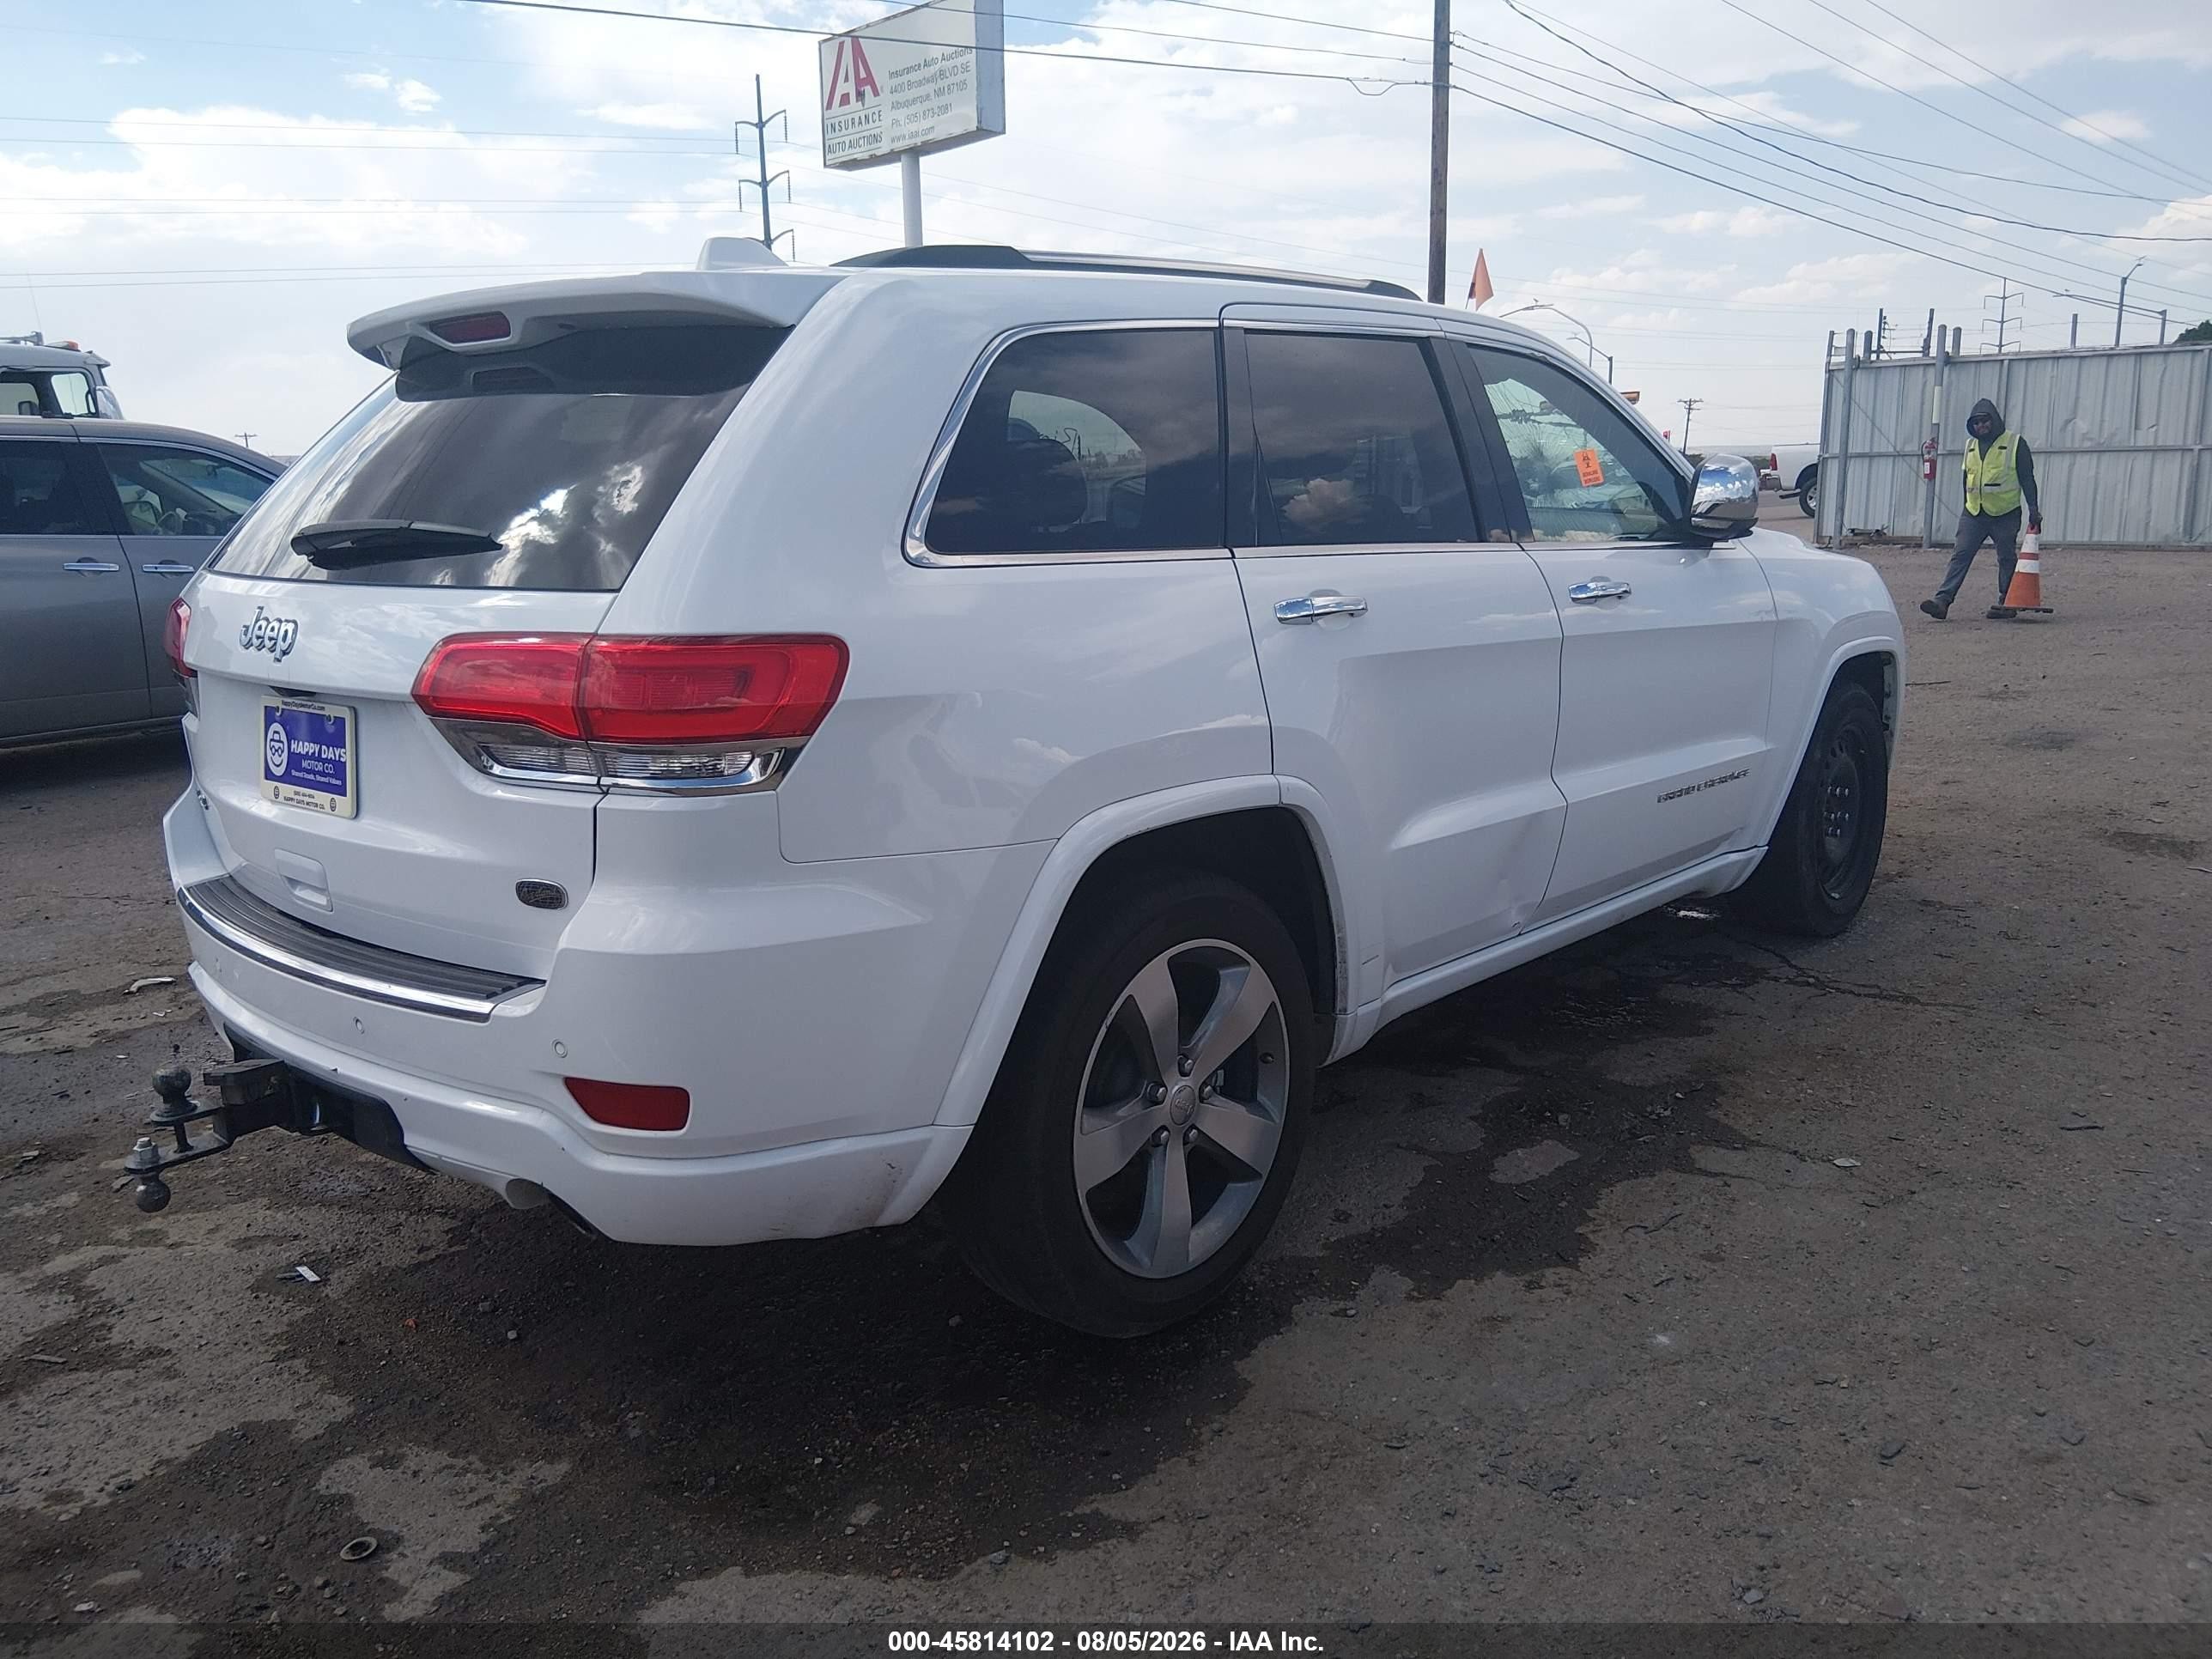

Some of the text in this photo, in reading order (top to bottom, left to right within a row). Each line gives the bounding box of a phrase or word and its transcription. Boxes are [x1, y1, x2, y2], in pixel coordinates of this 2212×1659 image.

[888, 47, 973, 80] Insurance Auto Auctions
[890, 61, 971, 94] 4400 Broadway BLVD SE
[933, 87, 945, 99] NM
[946, 79, 969, 95] 87105
[826, 110, 883, 135] INSURANCE
[903, 112, 921, 127] (505)
[827, 131, 883, 155] AUTO AUCTIONS
[890, 126, 935, 143] www.iaai.com
[239, 606, 299, 663] Jeep
[291, 739, 347, 763] HAPPY DAYS
[302, 759, 335, 774] MOTOR CO.
